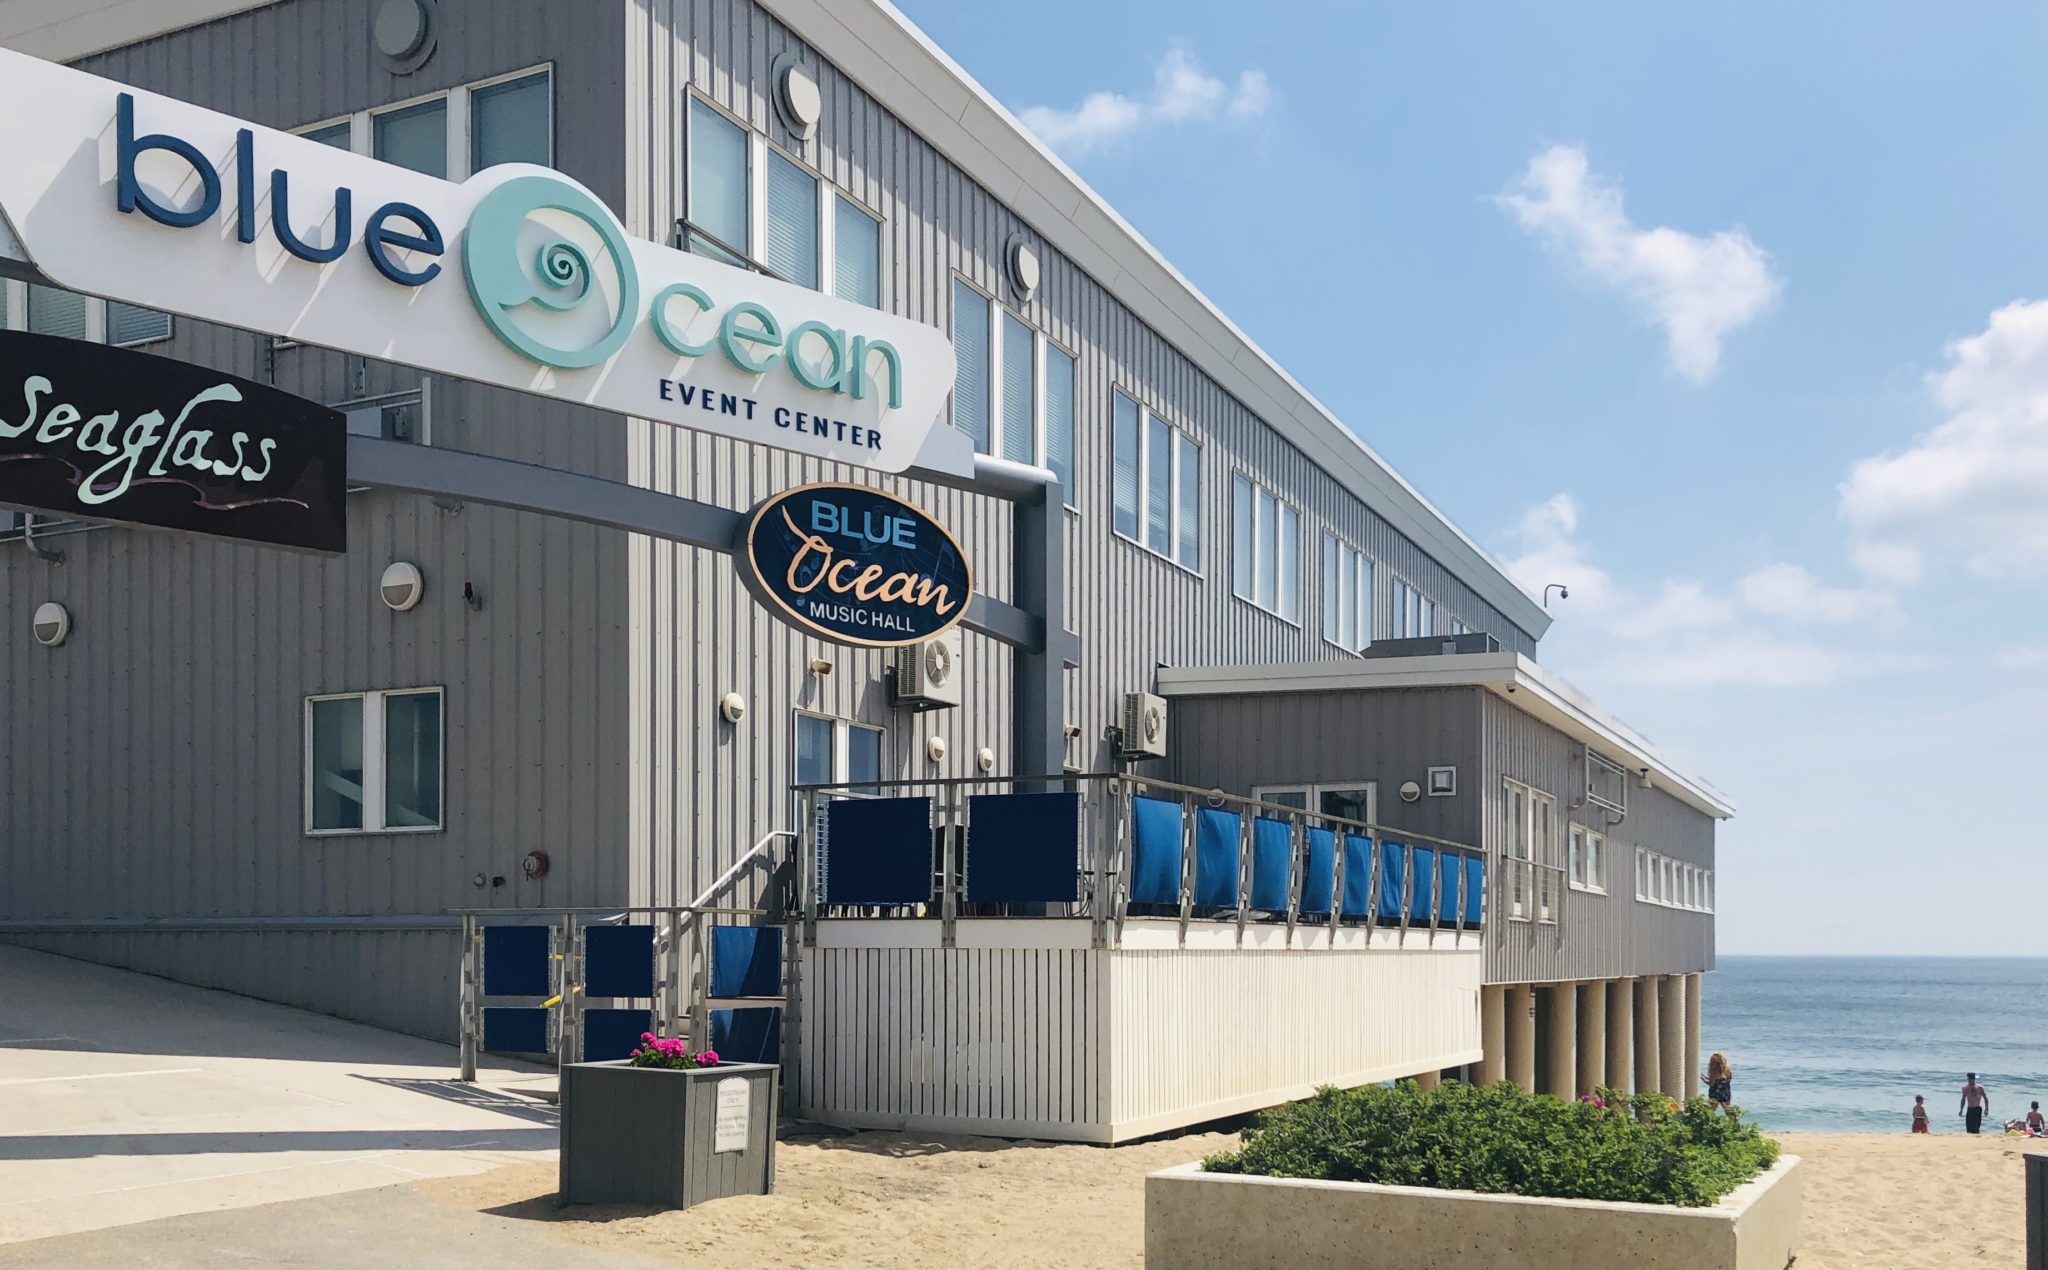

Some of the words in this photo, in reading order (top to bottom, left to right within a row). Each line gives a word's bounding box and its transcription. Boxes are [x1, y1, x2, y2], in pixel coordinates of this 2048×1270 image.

[117, 93, 443, 286] blue
[0, 375, 277, 505] Seaglass
[659, 379, 757, 420] EVENT
[774, 407, 882, 450] CENTER
[782, 504, 956, 615] Ocean
[811, 500, 917, 550] BLUE
[810, 602, 868, 626] MUSIC
[871, 612, 916, 633] HALL
